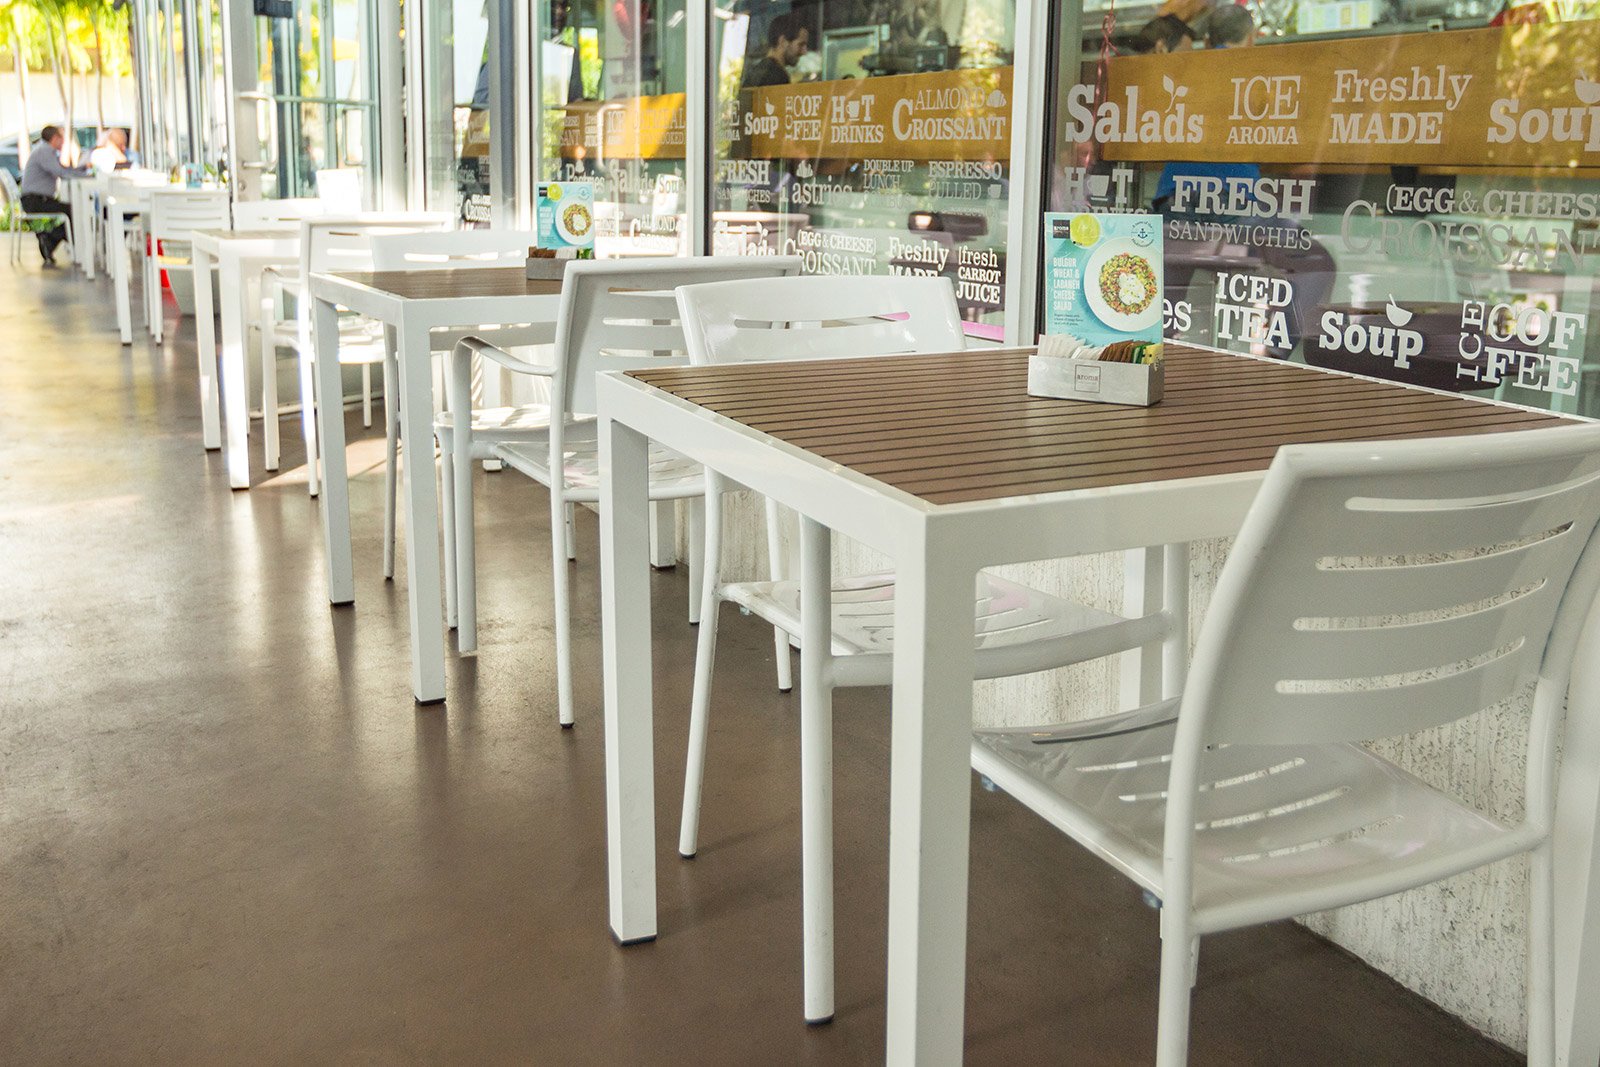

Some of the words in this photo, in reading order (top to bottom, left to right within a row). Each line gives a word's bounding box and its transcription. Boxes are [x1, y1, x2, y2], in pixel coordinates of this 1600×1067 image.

[915, 87, 986, 111] ALMOND
[1228, 75, 1302, 121] ICE
[1331, 65, 1473, 110] Freshly
[793, 95, 822, 117] COF
[892, 98, 1006, 141] CROISSANT
[1065, 84, 1205, 144] Salads
[744, 112, 779, 139] Soup
[793, 120, 822, 140] FEE
[831, 125, 884, 144] DRINKS
[1226, 126, 1299, 145] AROMA
[1329, 112, 1444, 144] MADE
[718, 160, 770, 185] FRESH
[863, 159, 899, 172] DOUBLE
[901, 160, 914, 172] UP
[928, 160, 1002, 181] ESPRESSO
[863, 174, 900, 190] LUNCH
[928, 180, 982, 200] PULLED
[1170, 175, 1317, 220] FRESH
[1458, 190, 1479, 214] &
[1483, 189, 1600, 221] CHEES
[1169, 220, 1313, 250] SANDWICHES
[1341, 200, 1600, 272] CROISSAN
[888, 236, 949, 272] Freshly
[958, 266, 1002, 284] CARROT
[1215, 272, 1293, 307] ICED
[956, 281, 1001, 305] JUICE
[1214, 302, 1293, 350] TEA
[1319, 310, 1424, 369] Soup
[1456, 300, 1486, 382] ICE
[1488, 303, 1586, 350] COF
[1481, 346, 1580, 396] FEE
